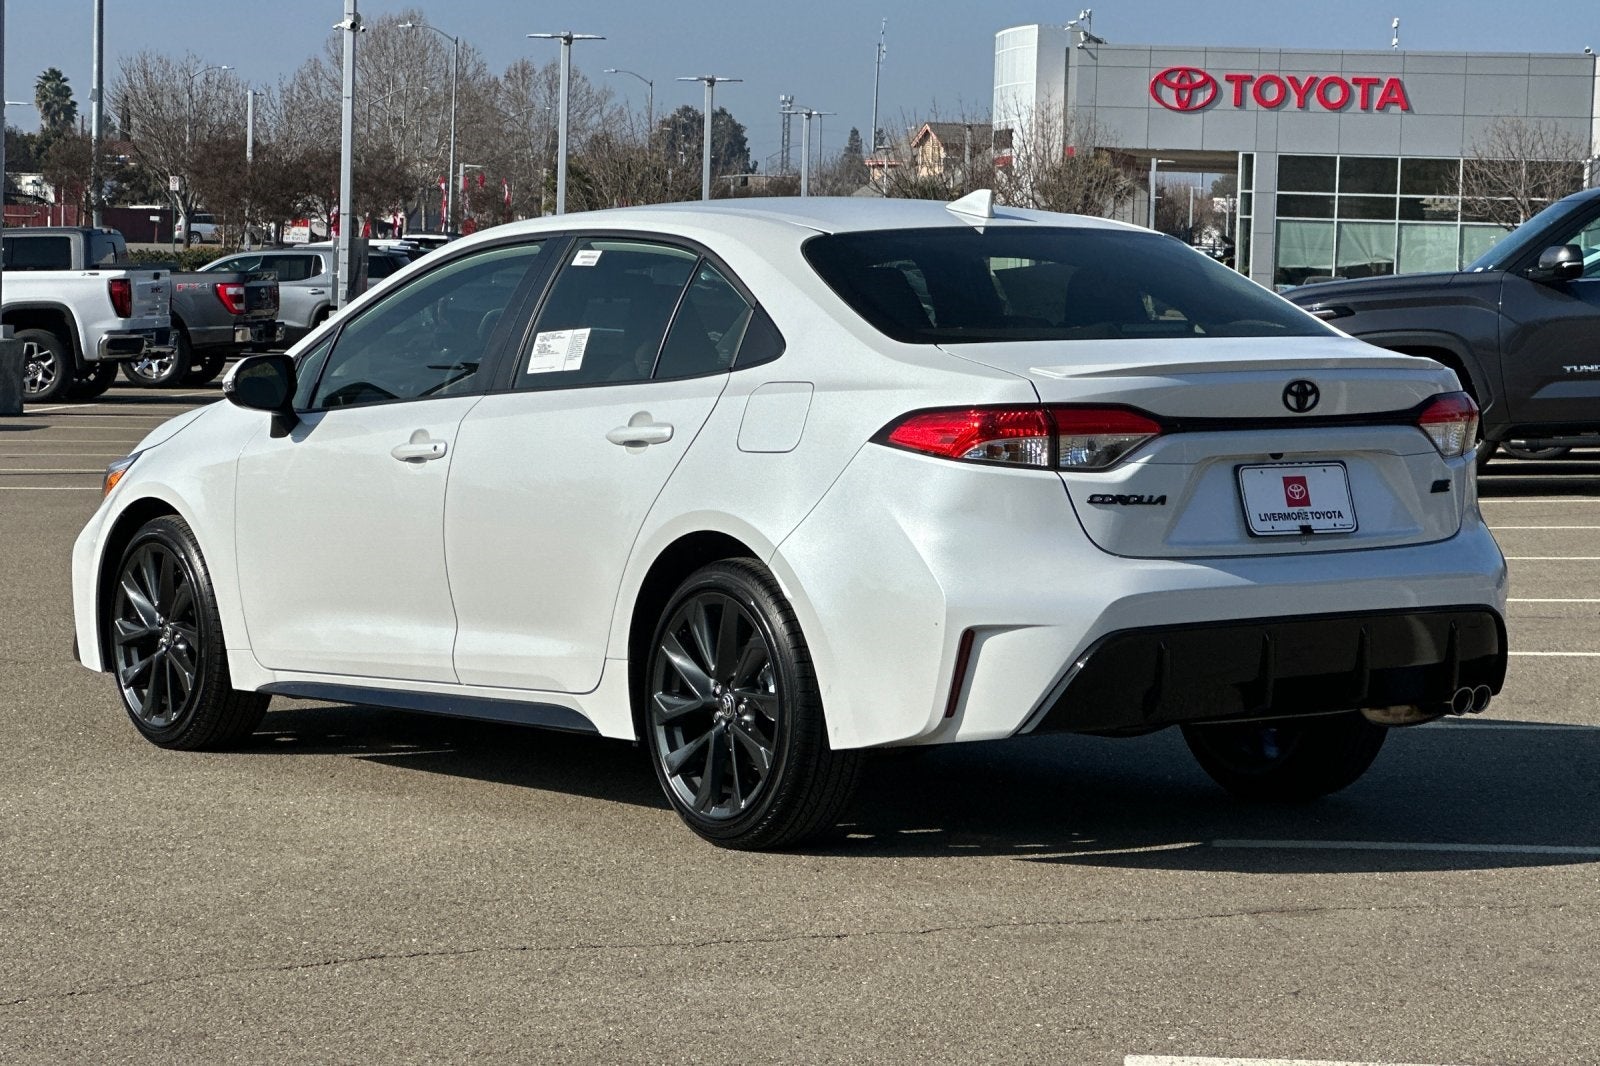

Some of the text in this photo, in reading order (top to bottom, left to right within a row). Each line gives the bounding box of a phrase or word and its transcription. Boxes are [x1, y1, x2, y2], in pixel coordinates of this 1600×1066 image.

[1225, 74, 1410, 112] TOYOTA
[1087, 494, 1167, 505] COROLLA
[1258, 510, 1344, 522] LIVERMORE TOYOTA
